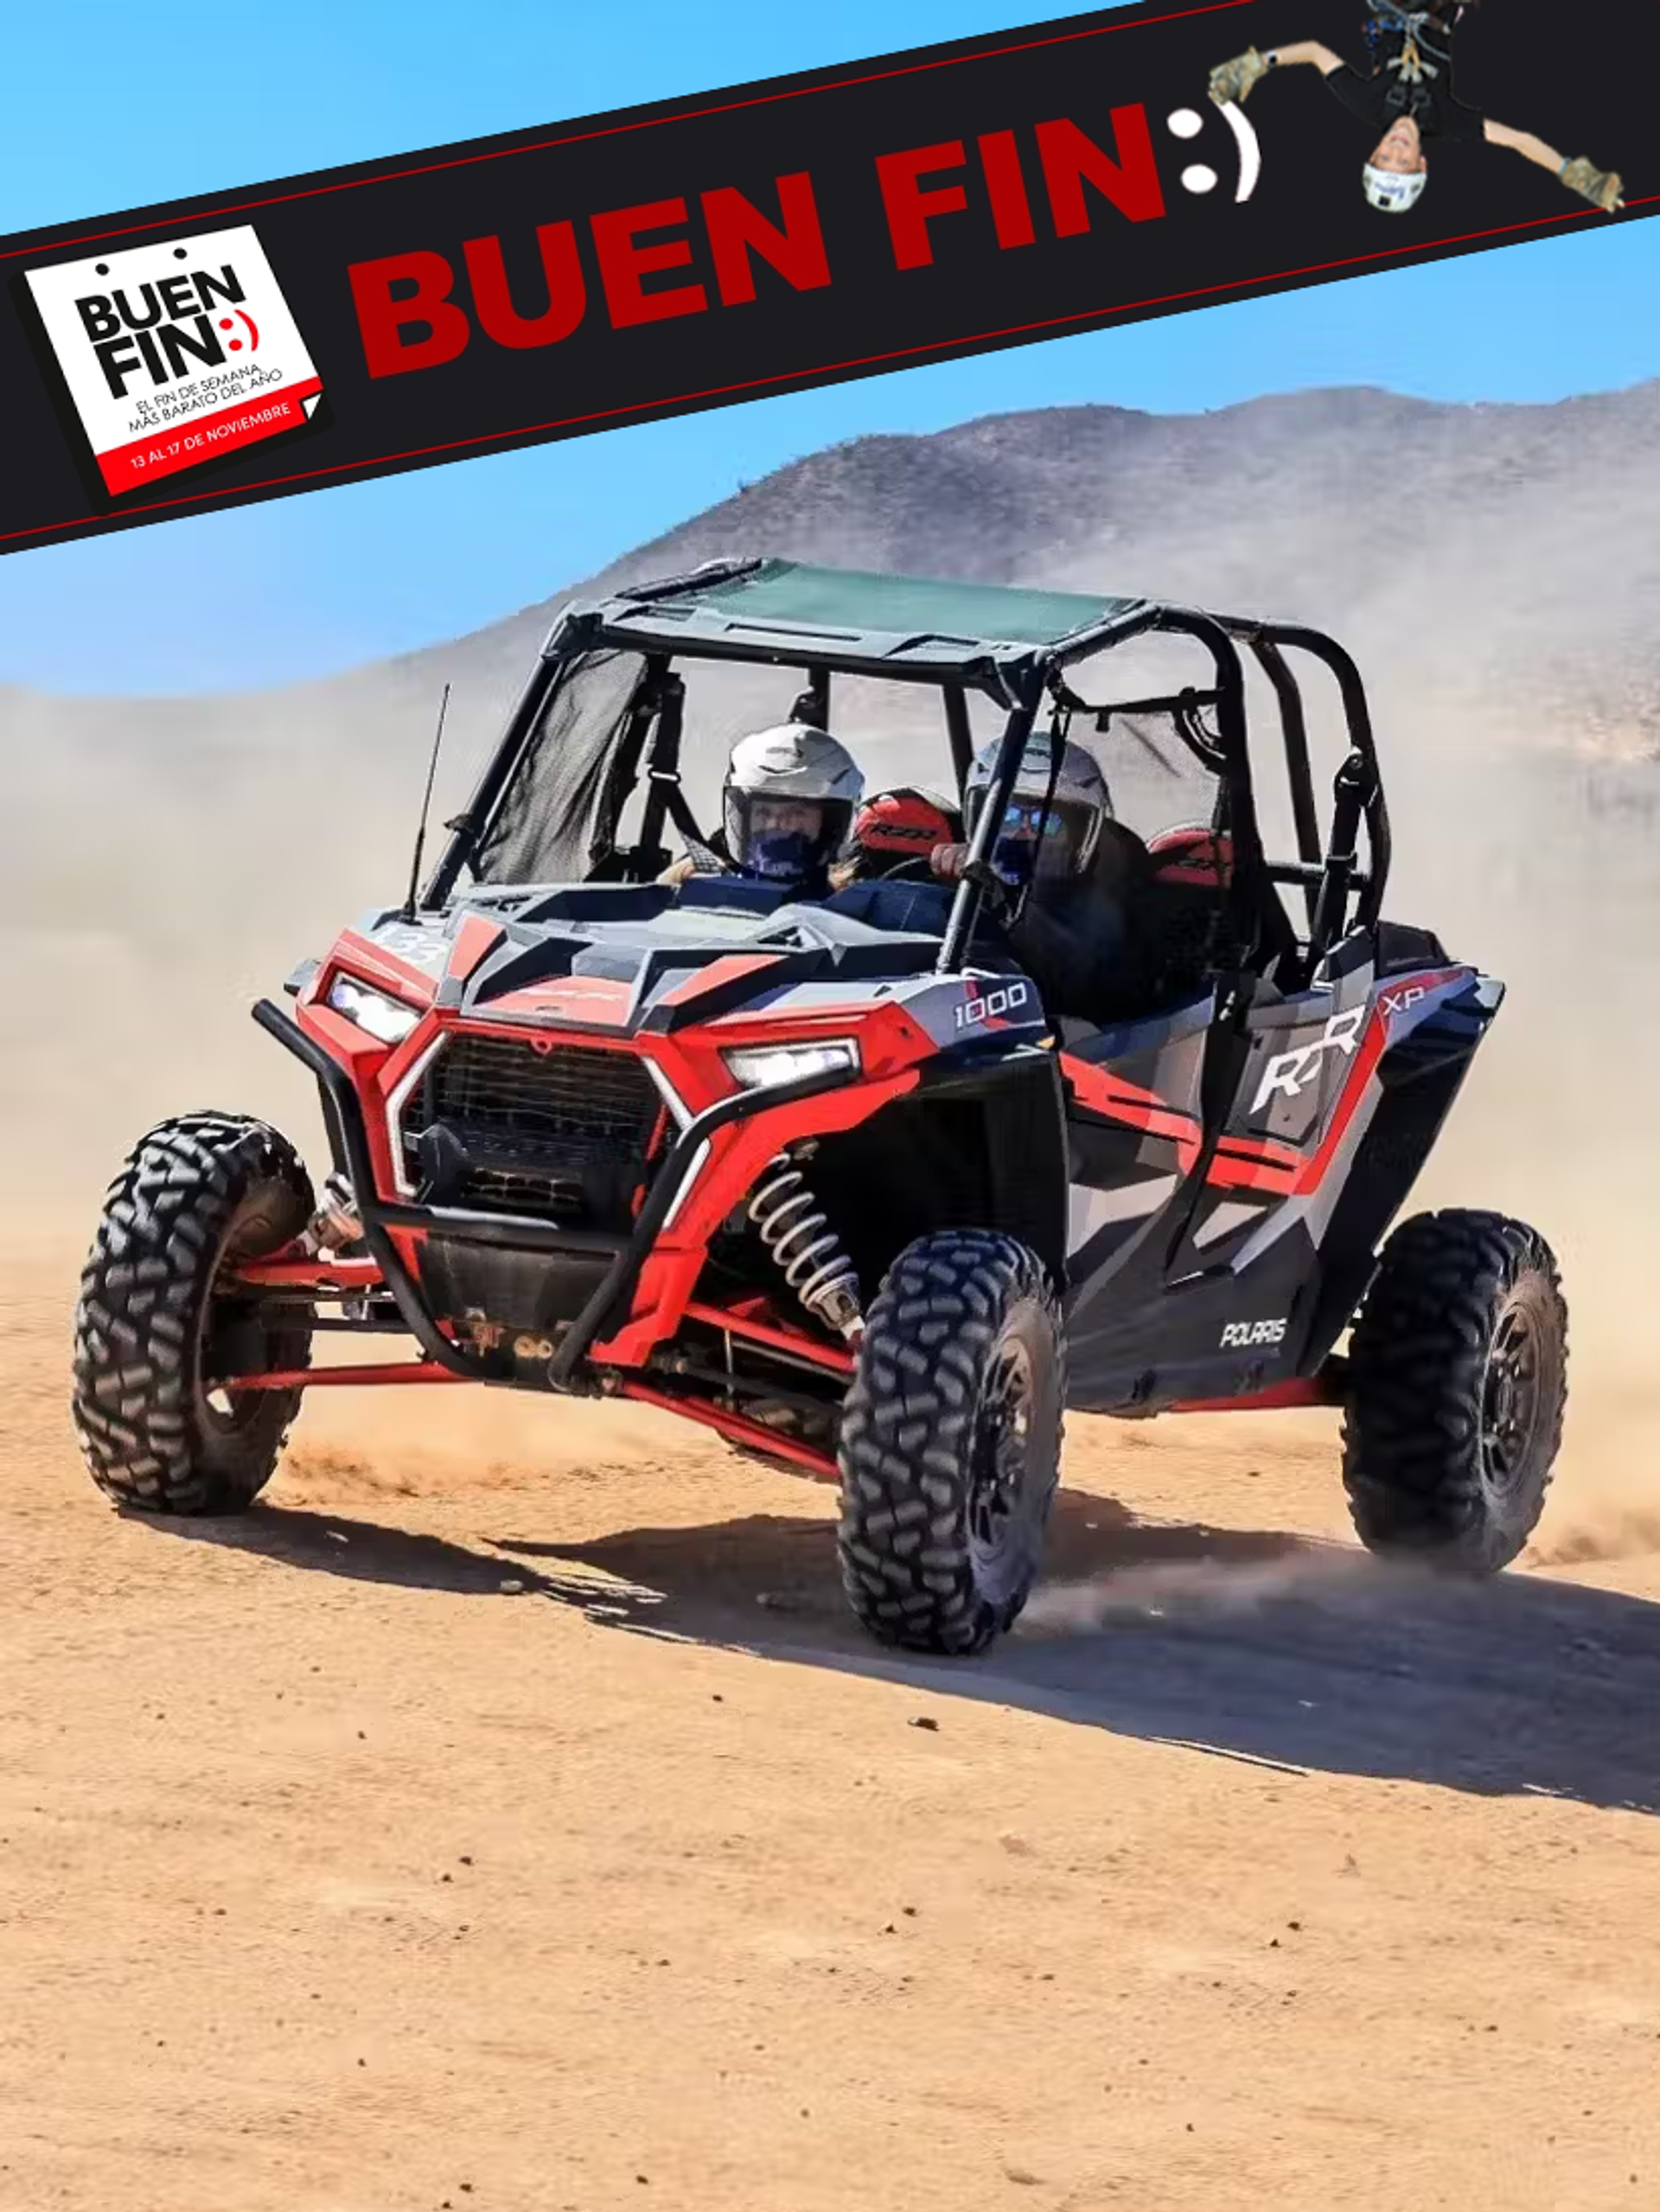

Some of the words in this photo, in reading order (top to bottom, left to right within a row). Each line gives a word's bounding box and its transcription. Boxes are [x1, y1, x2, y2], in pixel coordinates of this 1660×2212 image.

[955, 982, 1027, 1028] 1000
[1382, 986, 1425, 1016] XP
[1219, 1318, 1286, 1348] POLARIS
